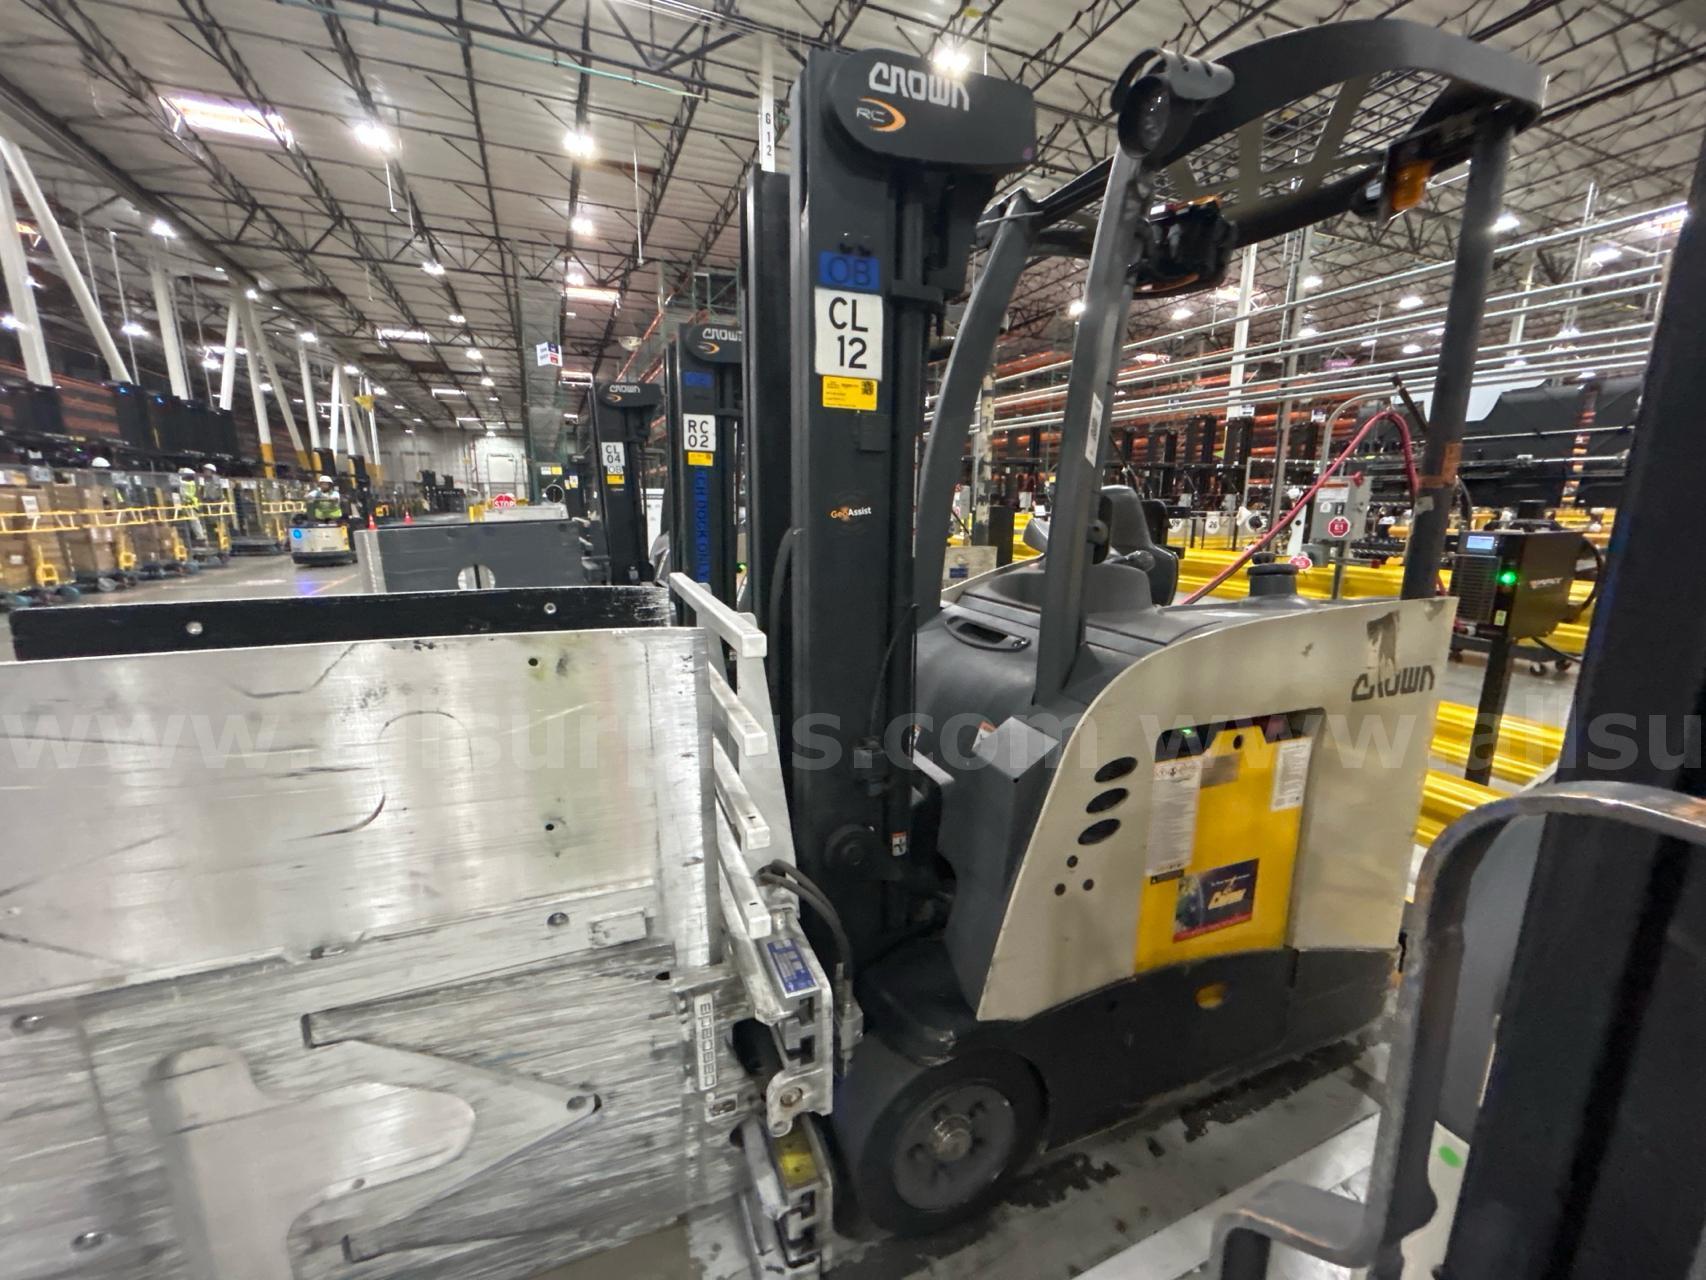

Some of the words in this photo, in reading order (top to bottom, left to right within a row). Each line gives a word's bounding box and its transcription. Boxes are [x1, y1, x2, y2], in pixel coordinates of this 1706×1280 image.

[868, 61, 970, 112] CROWN
[856, 107, 888, 123] RC
[828, 256, 871, 286] OB
[828, 296, 869, 333] CL
[837, 335, 867, 370] 12
[688, 419, 709, 435] RC
[605, 444, 620, 454] CL
[688, 434, 709, 448] 02
[606, 454, 621, 464] 04
[494, 499, 515, 508] STOP
